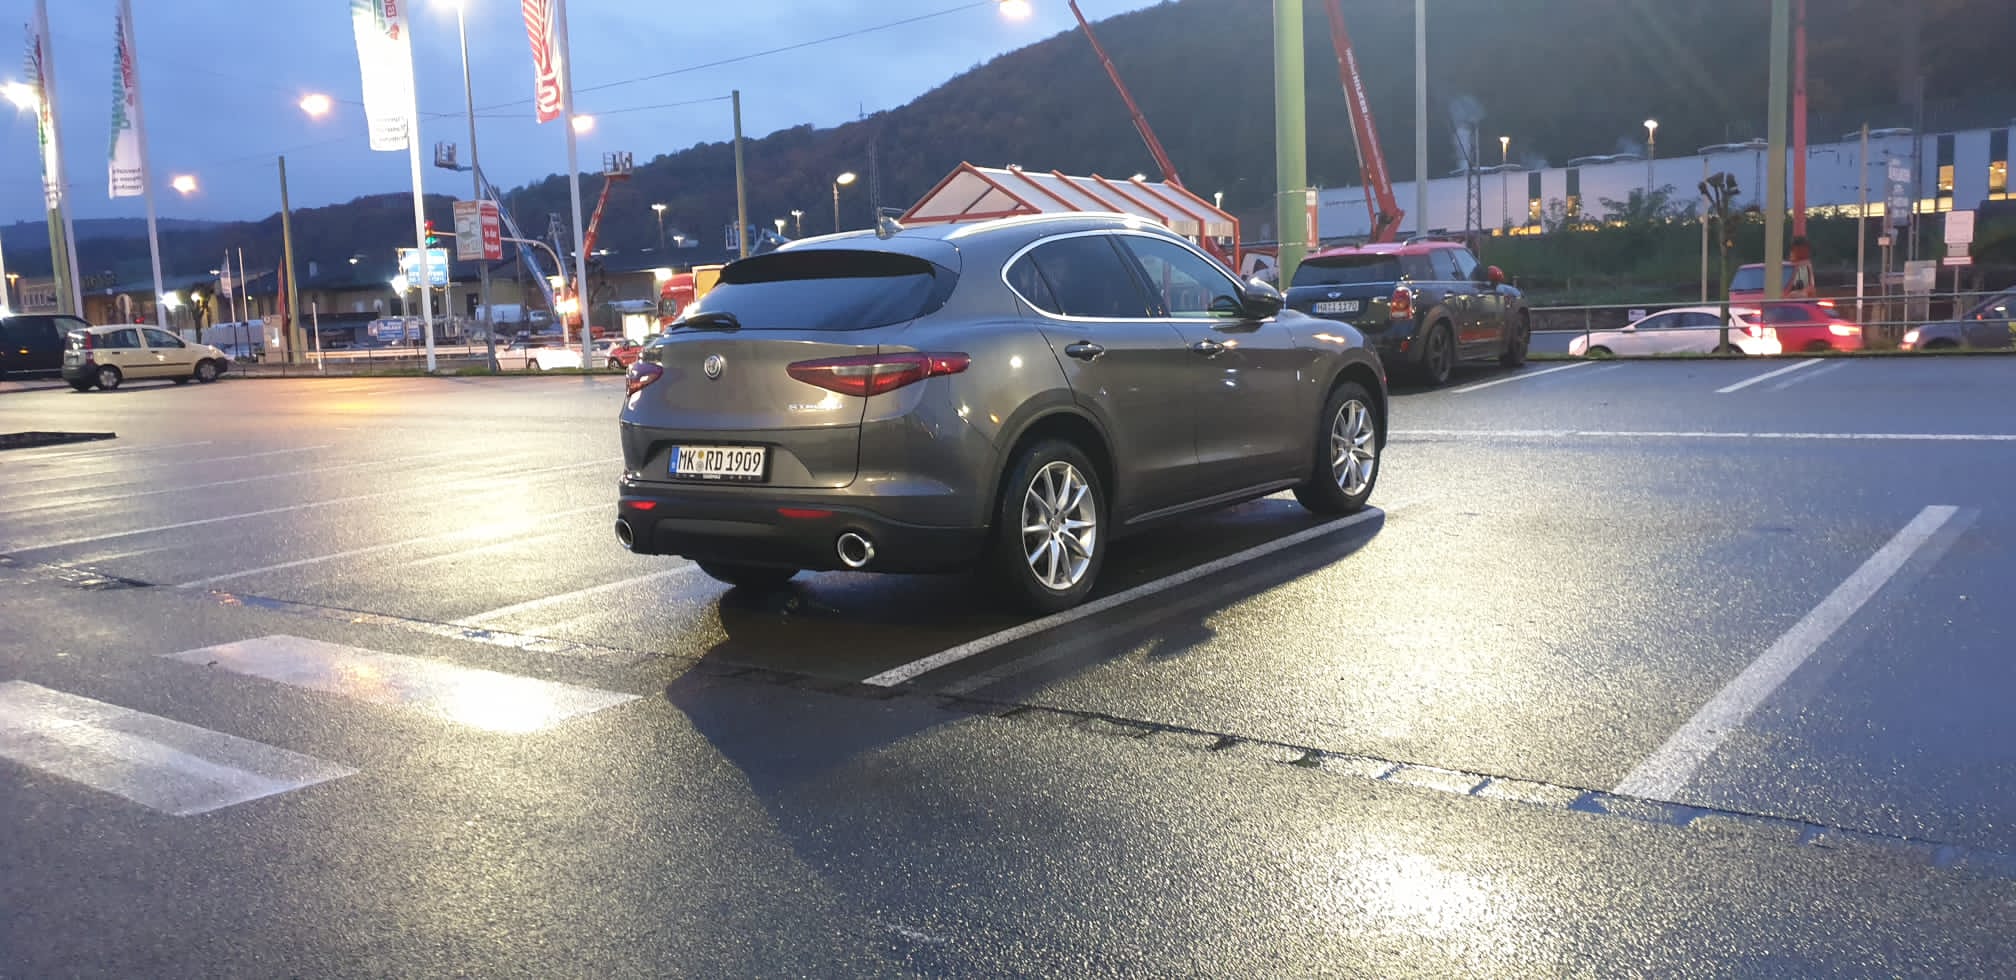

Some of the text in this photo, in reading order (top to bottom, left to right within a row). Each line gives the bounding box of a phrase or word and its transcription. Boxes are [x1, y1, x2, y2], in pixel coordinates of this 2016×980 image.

[678, 450, 761, 472] MK RD 1909
